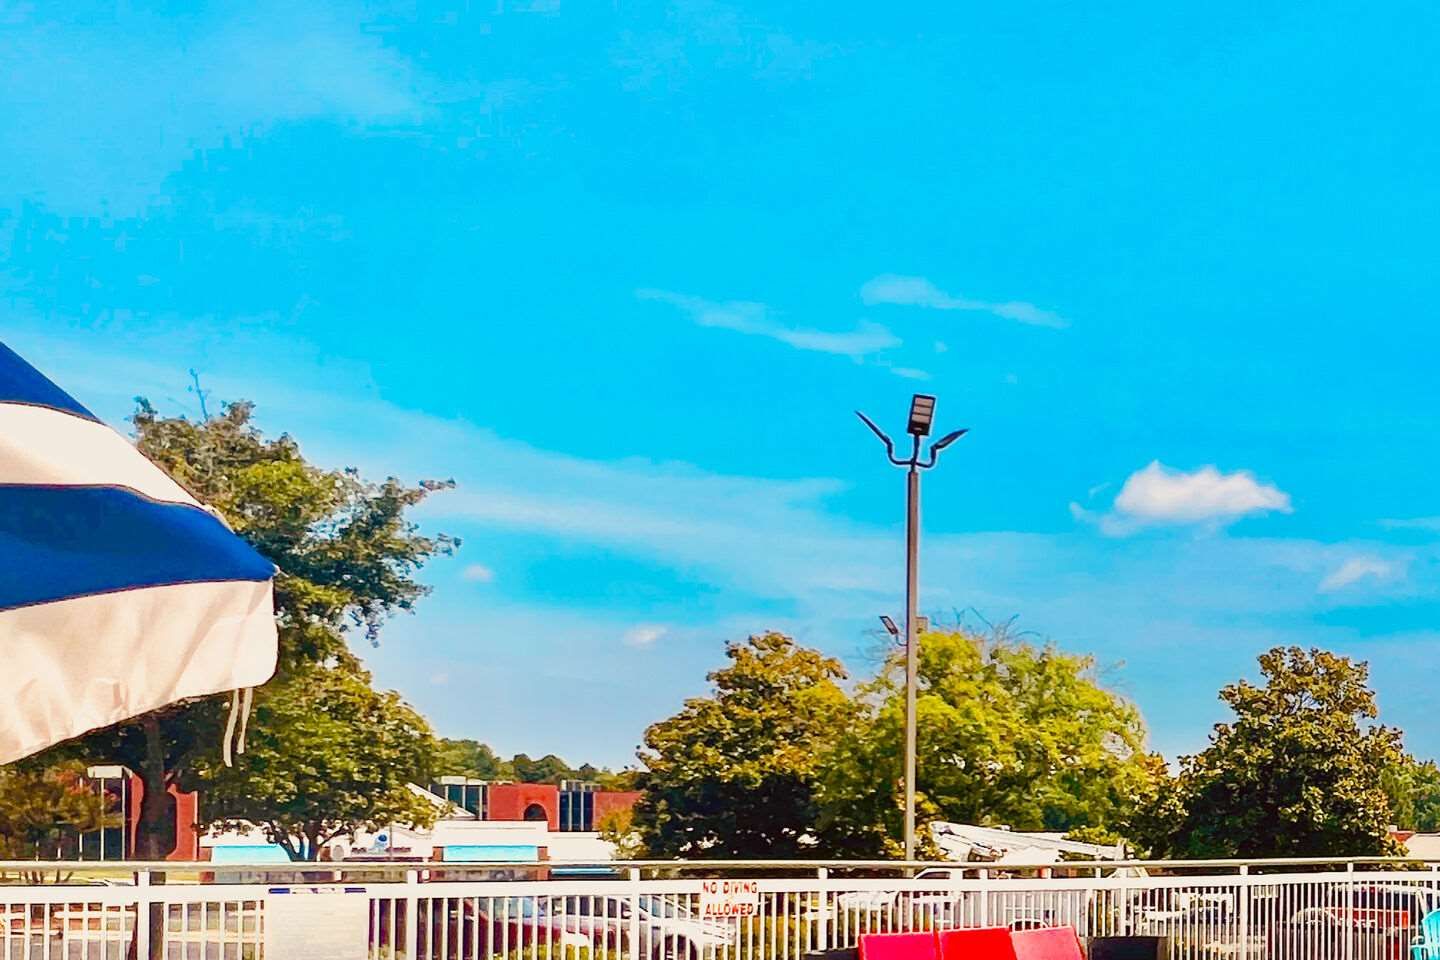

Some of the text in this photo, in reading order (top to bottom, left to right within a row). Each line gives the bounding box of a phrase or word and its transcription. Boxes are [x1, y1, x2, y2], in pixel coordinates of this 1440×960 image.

[703, 881, 757, 894] NO DIVING
[705, 903, 754, 915] ALLOWED
